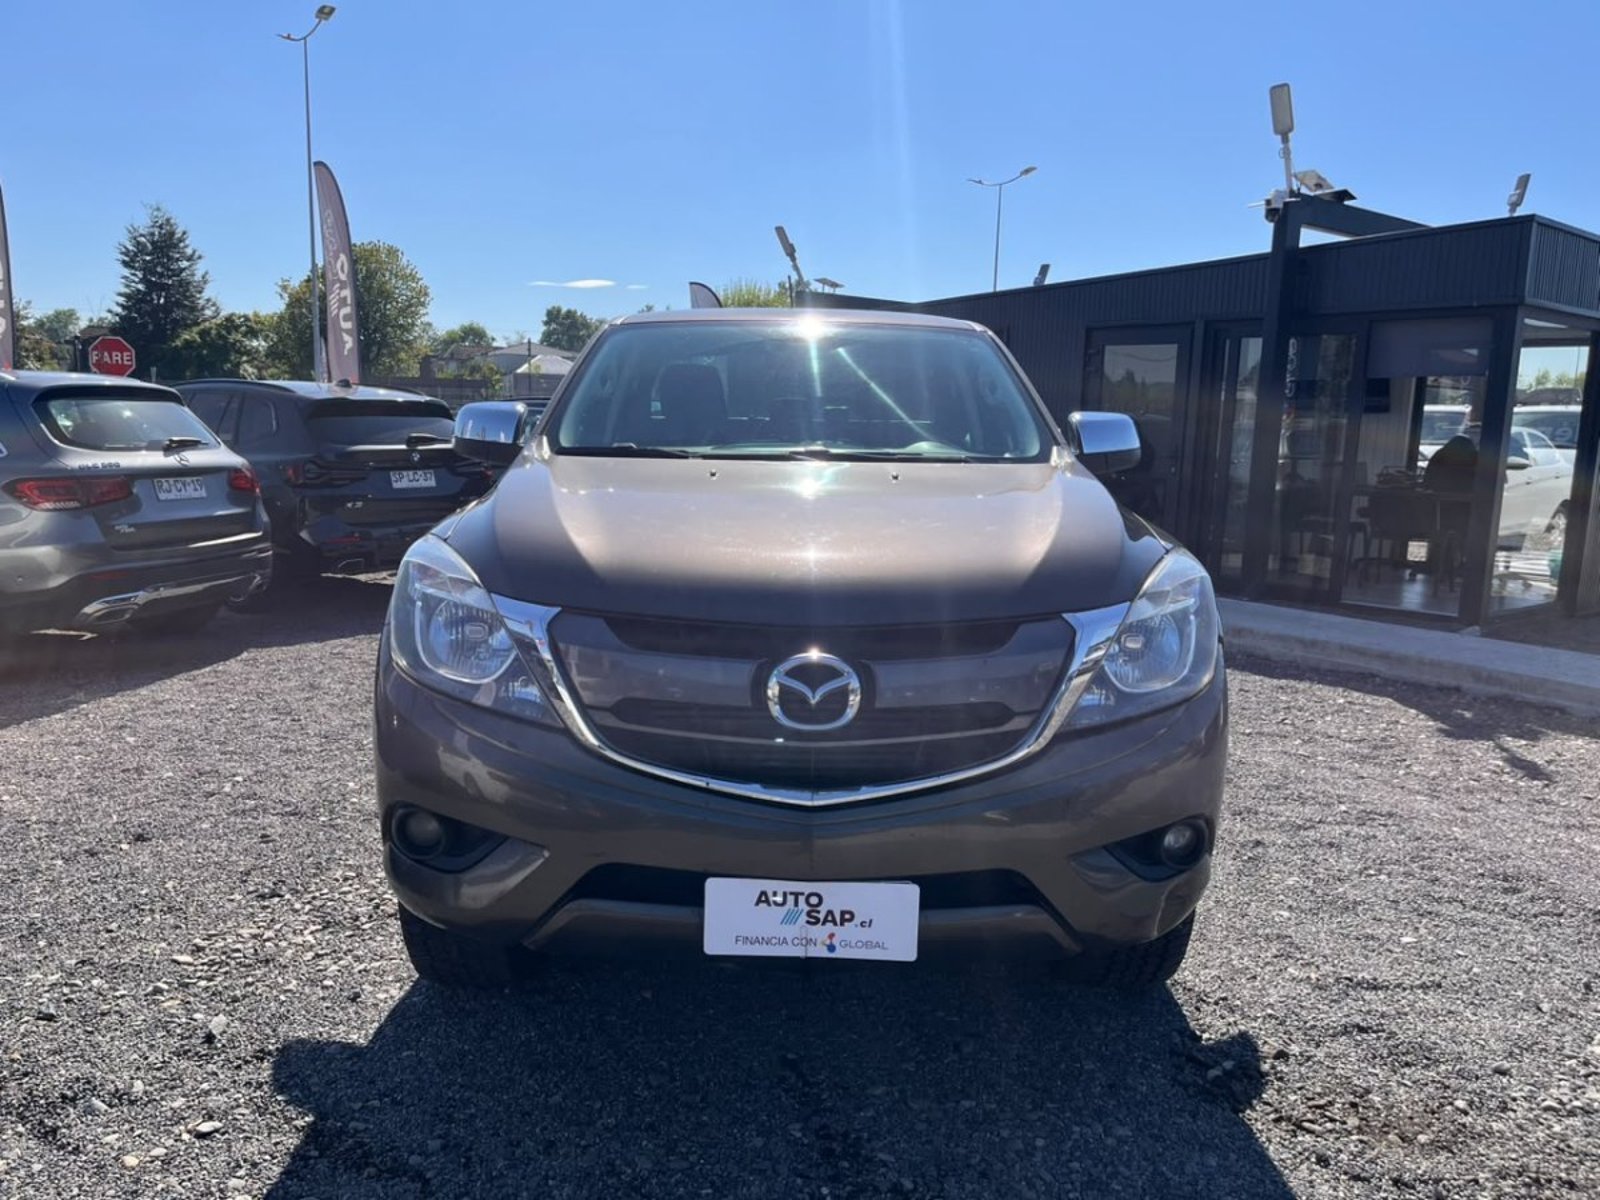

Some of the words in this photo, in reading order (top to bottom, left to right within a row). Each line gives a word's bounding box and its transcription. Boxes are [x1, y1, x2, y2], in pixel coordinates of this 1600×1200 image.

[92, 350, 132, 365] PARE
[754, 890, 824, 908] AUTO
[805, 908, 873, 929] SAP.cl
[735, 935, 789, 947] FINANCIA
[791, 936, 817, 948] CON
[839, 939, 888, 951] GLOBAL
